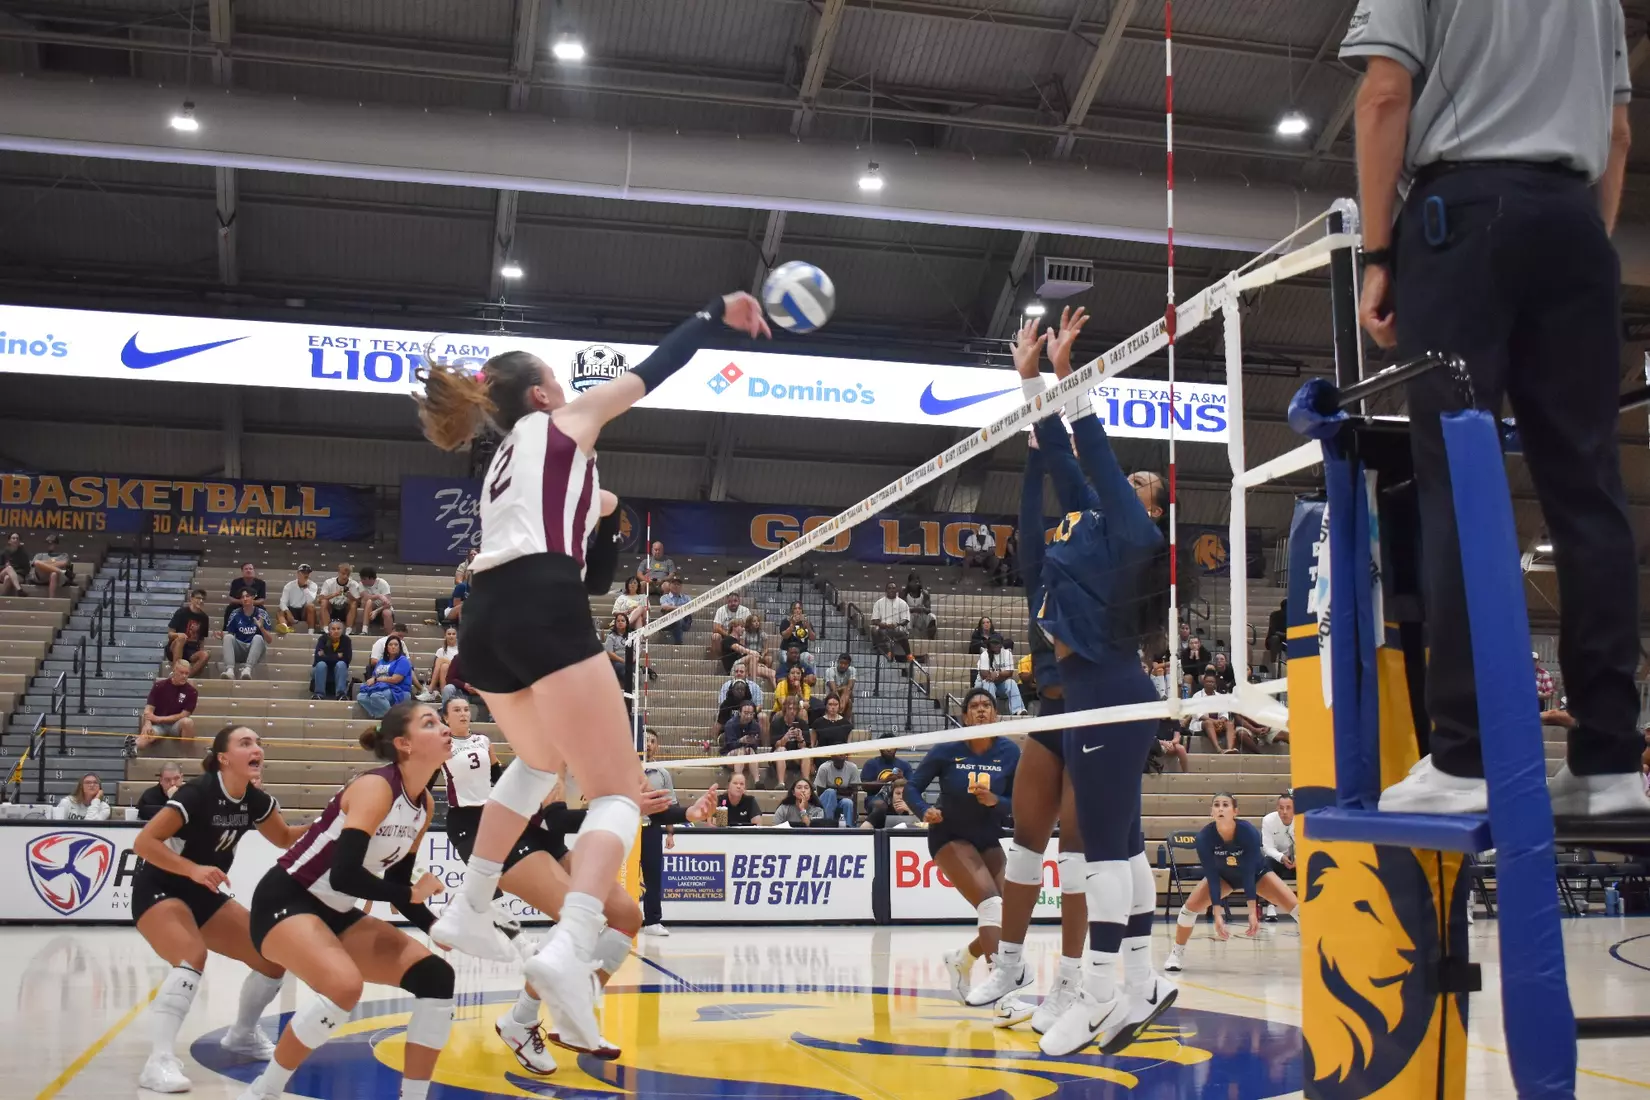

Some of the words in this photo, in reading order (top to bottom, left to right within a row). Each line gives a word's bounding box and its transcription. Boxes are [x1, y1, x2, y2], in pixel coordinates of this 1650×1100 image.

[308, 335, 361, 349] EAST
[370, 339, 436, 353] TEXAS
[445, 344, 490, 357] A&M
[748, 377, 875, 405] Domino's
[1087, 386, 1120, 397] AST
[1127, 388, 1182, 402] TEXAS
[1190, 393, 1226, 404] A&M
[1098, 398, 1227, 433] IONS
[0, 473, 331, 517] BASKETBALL
[177, 516, 317, 540] ALL-AMERICANS
[749, 513, 852, 553] GO
[467, 752, 481, 770] 3
[977, 764, 1002, 772] TEXAS
[967, 771, 991, 794] 10
[214, 829, 237, 852] 11
[1174, 835, 1197, 844] LION
[663, 856, 722, 873] Hilton
[731, 854, 792, 879] BEST
[796, 854, 868, 879] PLACE
[733, 881, 762, 905] TO
[768, 881, 832, 905] STAY!
